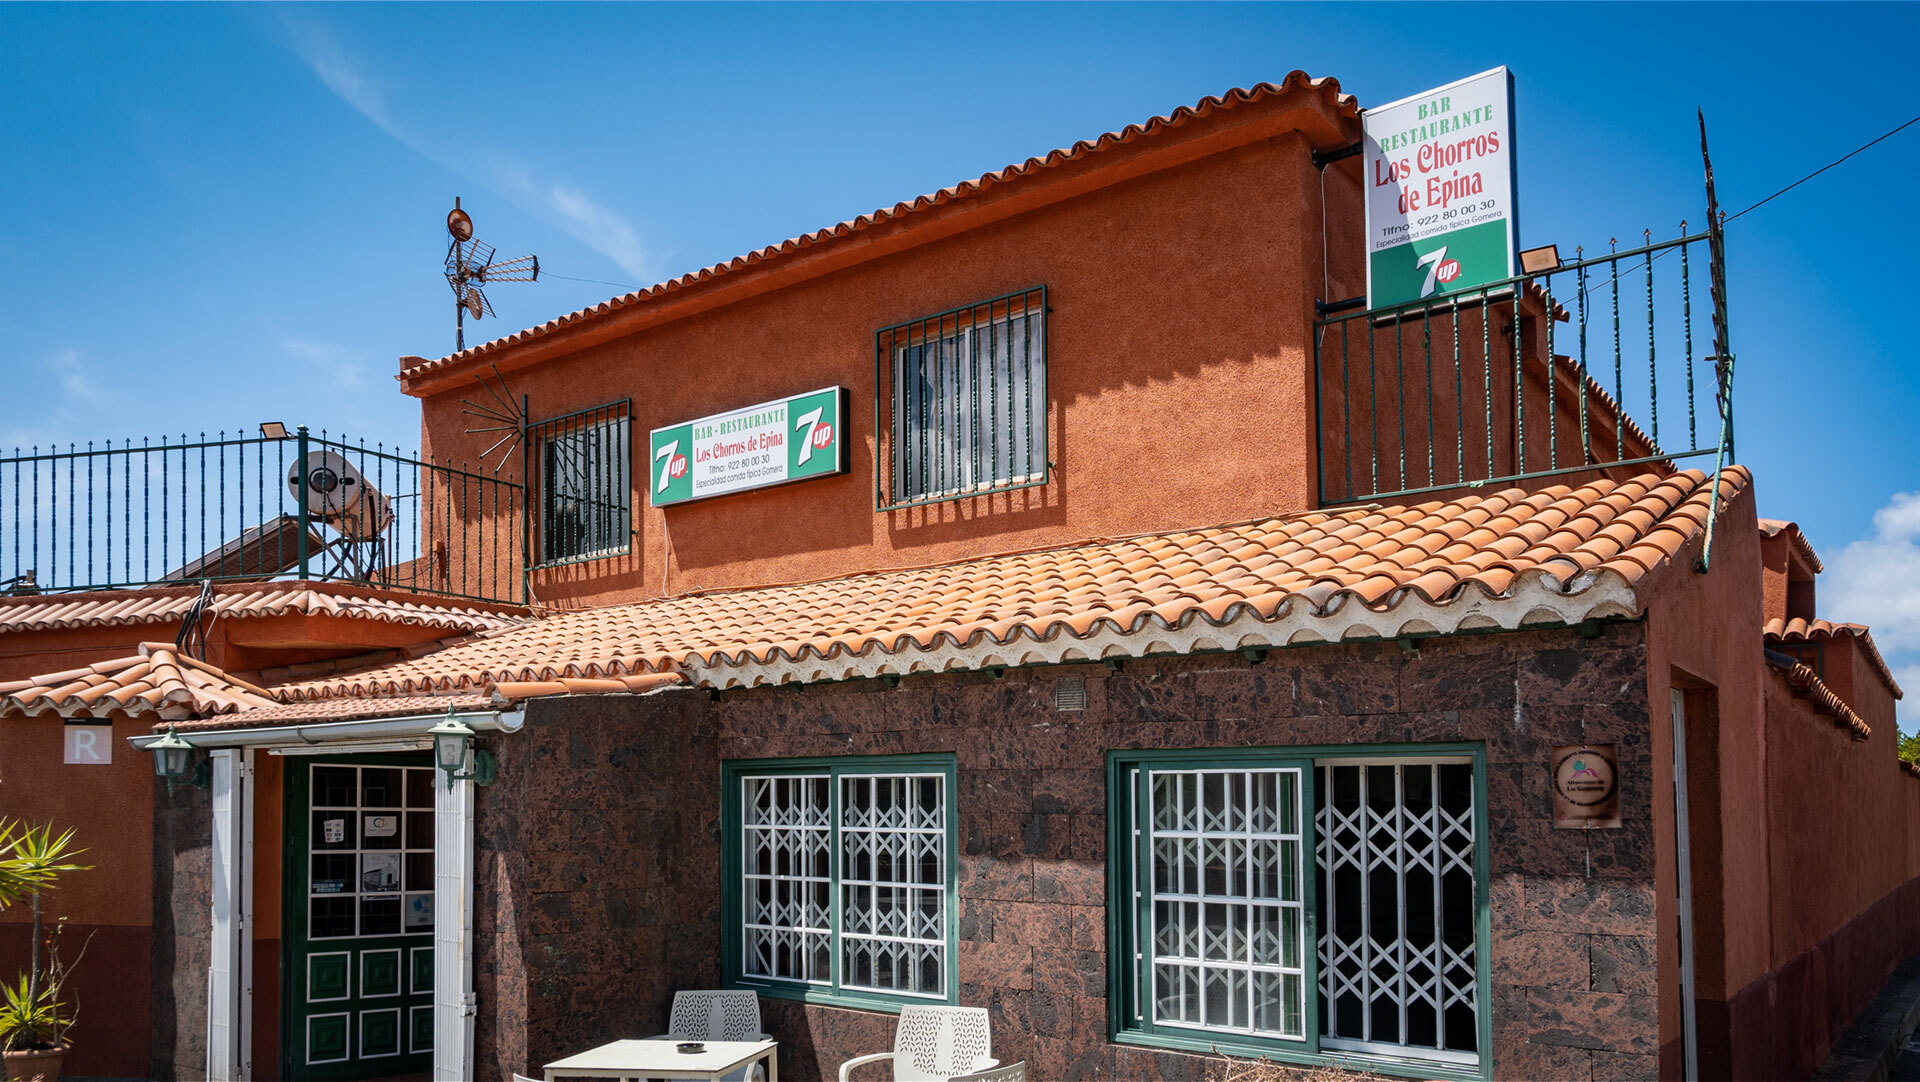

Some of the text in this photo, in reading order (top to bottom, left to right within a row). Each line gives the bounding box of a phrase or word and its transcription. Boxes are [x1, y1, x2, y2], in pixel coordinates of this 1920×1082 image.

[1418, 96, 1451, 120] BAR
[1380, 104, 1493, 154] RESTAURANTE
[1375, 131, 1500, 187] Los Chorros
[1398, 170, 1483, 215] de Epina
[1376, 233, 1419, 249] Especialidad
[1420, 224, 1448, 237] comida
[1471, 210, 1502, 223] Gomera
[1417, 214, 1439, 228] 922
[1442, 209, 1458, 220] 80
[1460, 204, 1476, 216] 00
[1480, 199, 1495, 211] 30
[695, 425, 713, 441] BAR
[720, 408, 785, 435] RESTAURANTE
[696, 430, 783, 463] Los Chorros de Epina
[727, 460, 740, 471] 922
[741, 457, 750, 468] 80
[751, 455, 760, 466] 00
[761, 453, 770, 464] 30
[696, 474, 727, 490] Especialidad
[727, 470, 746, 482] comida
[761, 464, 783, 476] Gomera
[75, 730, 99, 760] R
